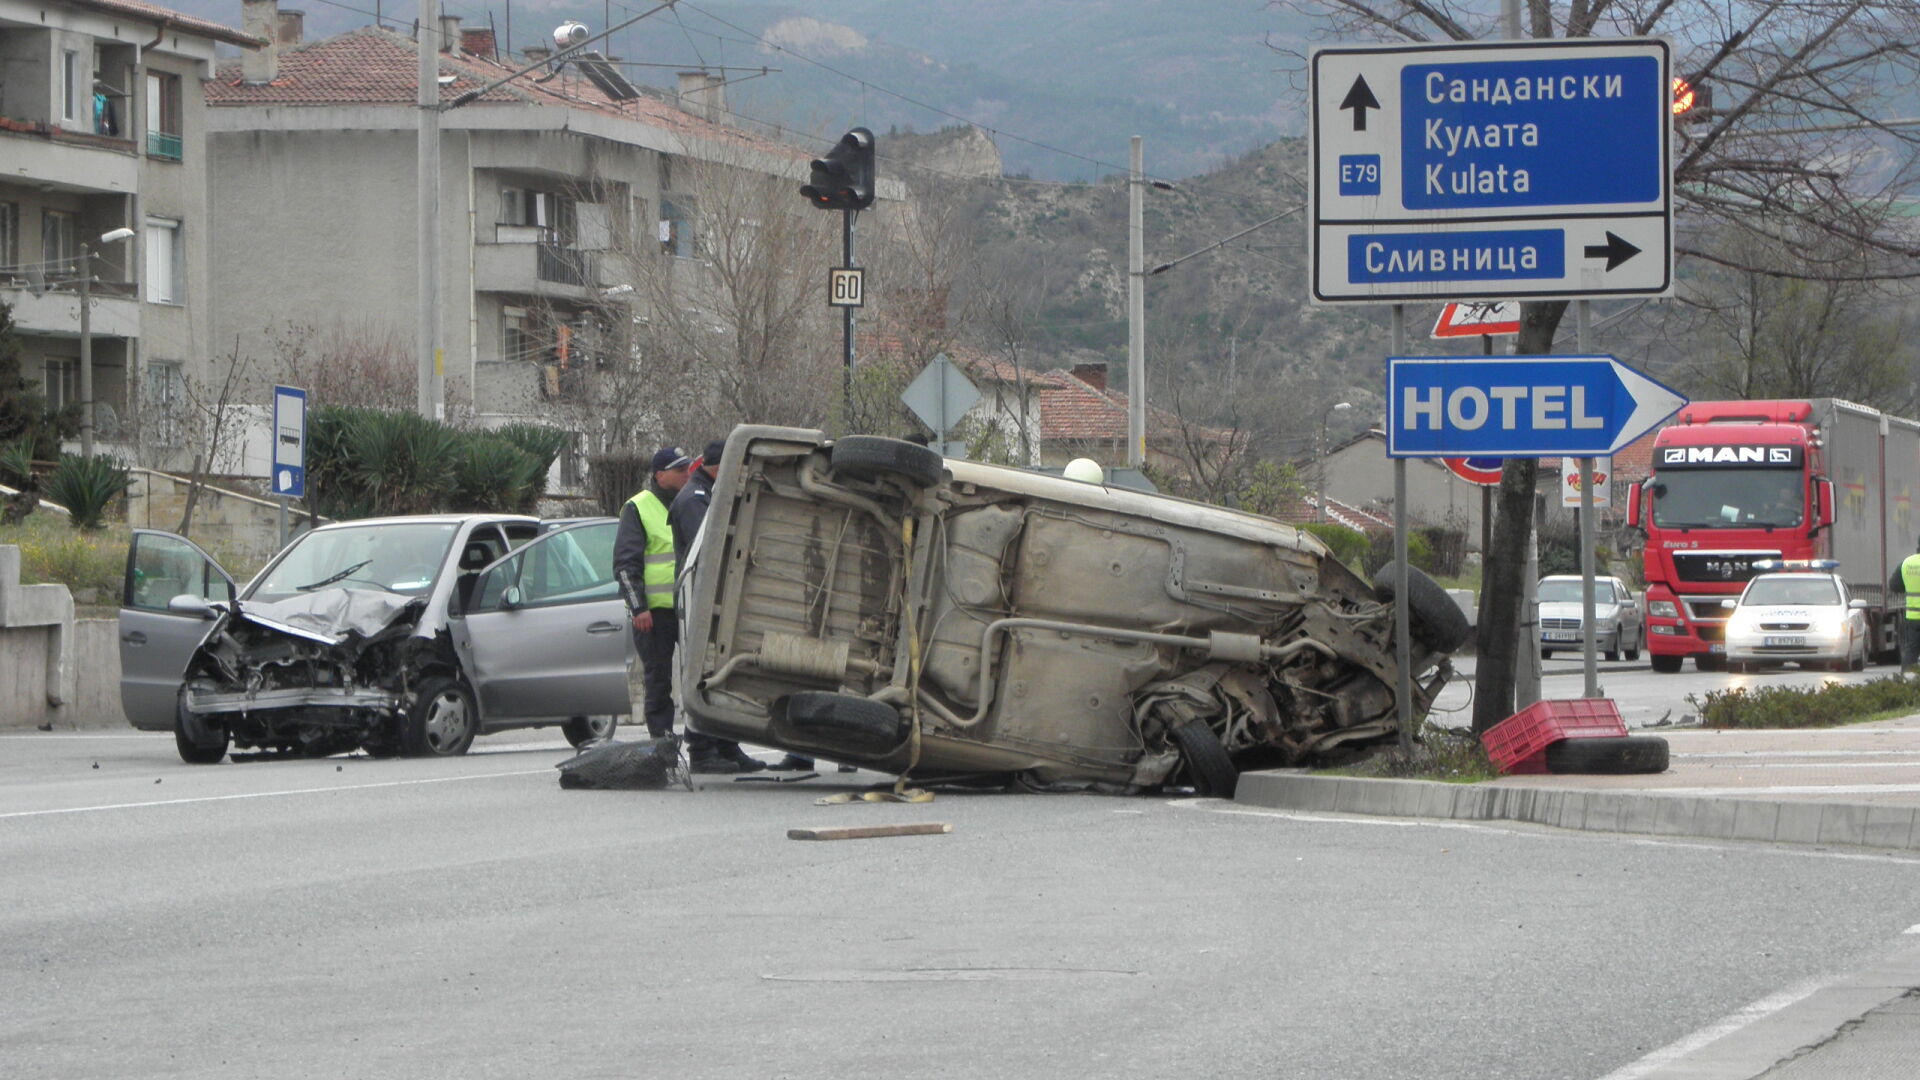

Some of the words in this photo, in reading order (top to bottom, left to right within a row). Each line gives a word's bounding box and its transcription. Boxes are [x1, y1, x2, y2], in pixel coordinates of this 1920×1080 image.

[1425, 72, 1622, 106] Сандански
[1424, 118, 1539, 157] Кулата
[1424, 163, 1530, 195] Kulata
[1364, 241, 1538, 274] Сливница
[835, 274, 859, 300] 60
[1403, 385, 1604, 431] HOTEL
[1687, 446, 1765, 463] MAN
[1706, 561, 1748, 572] MAN
